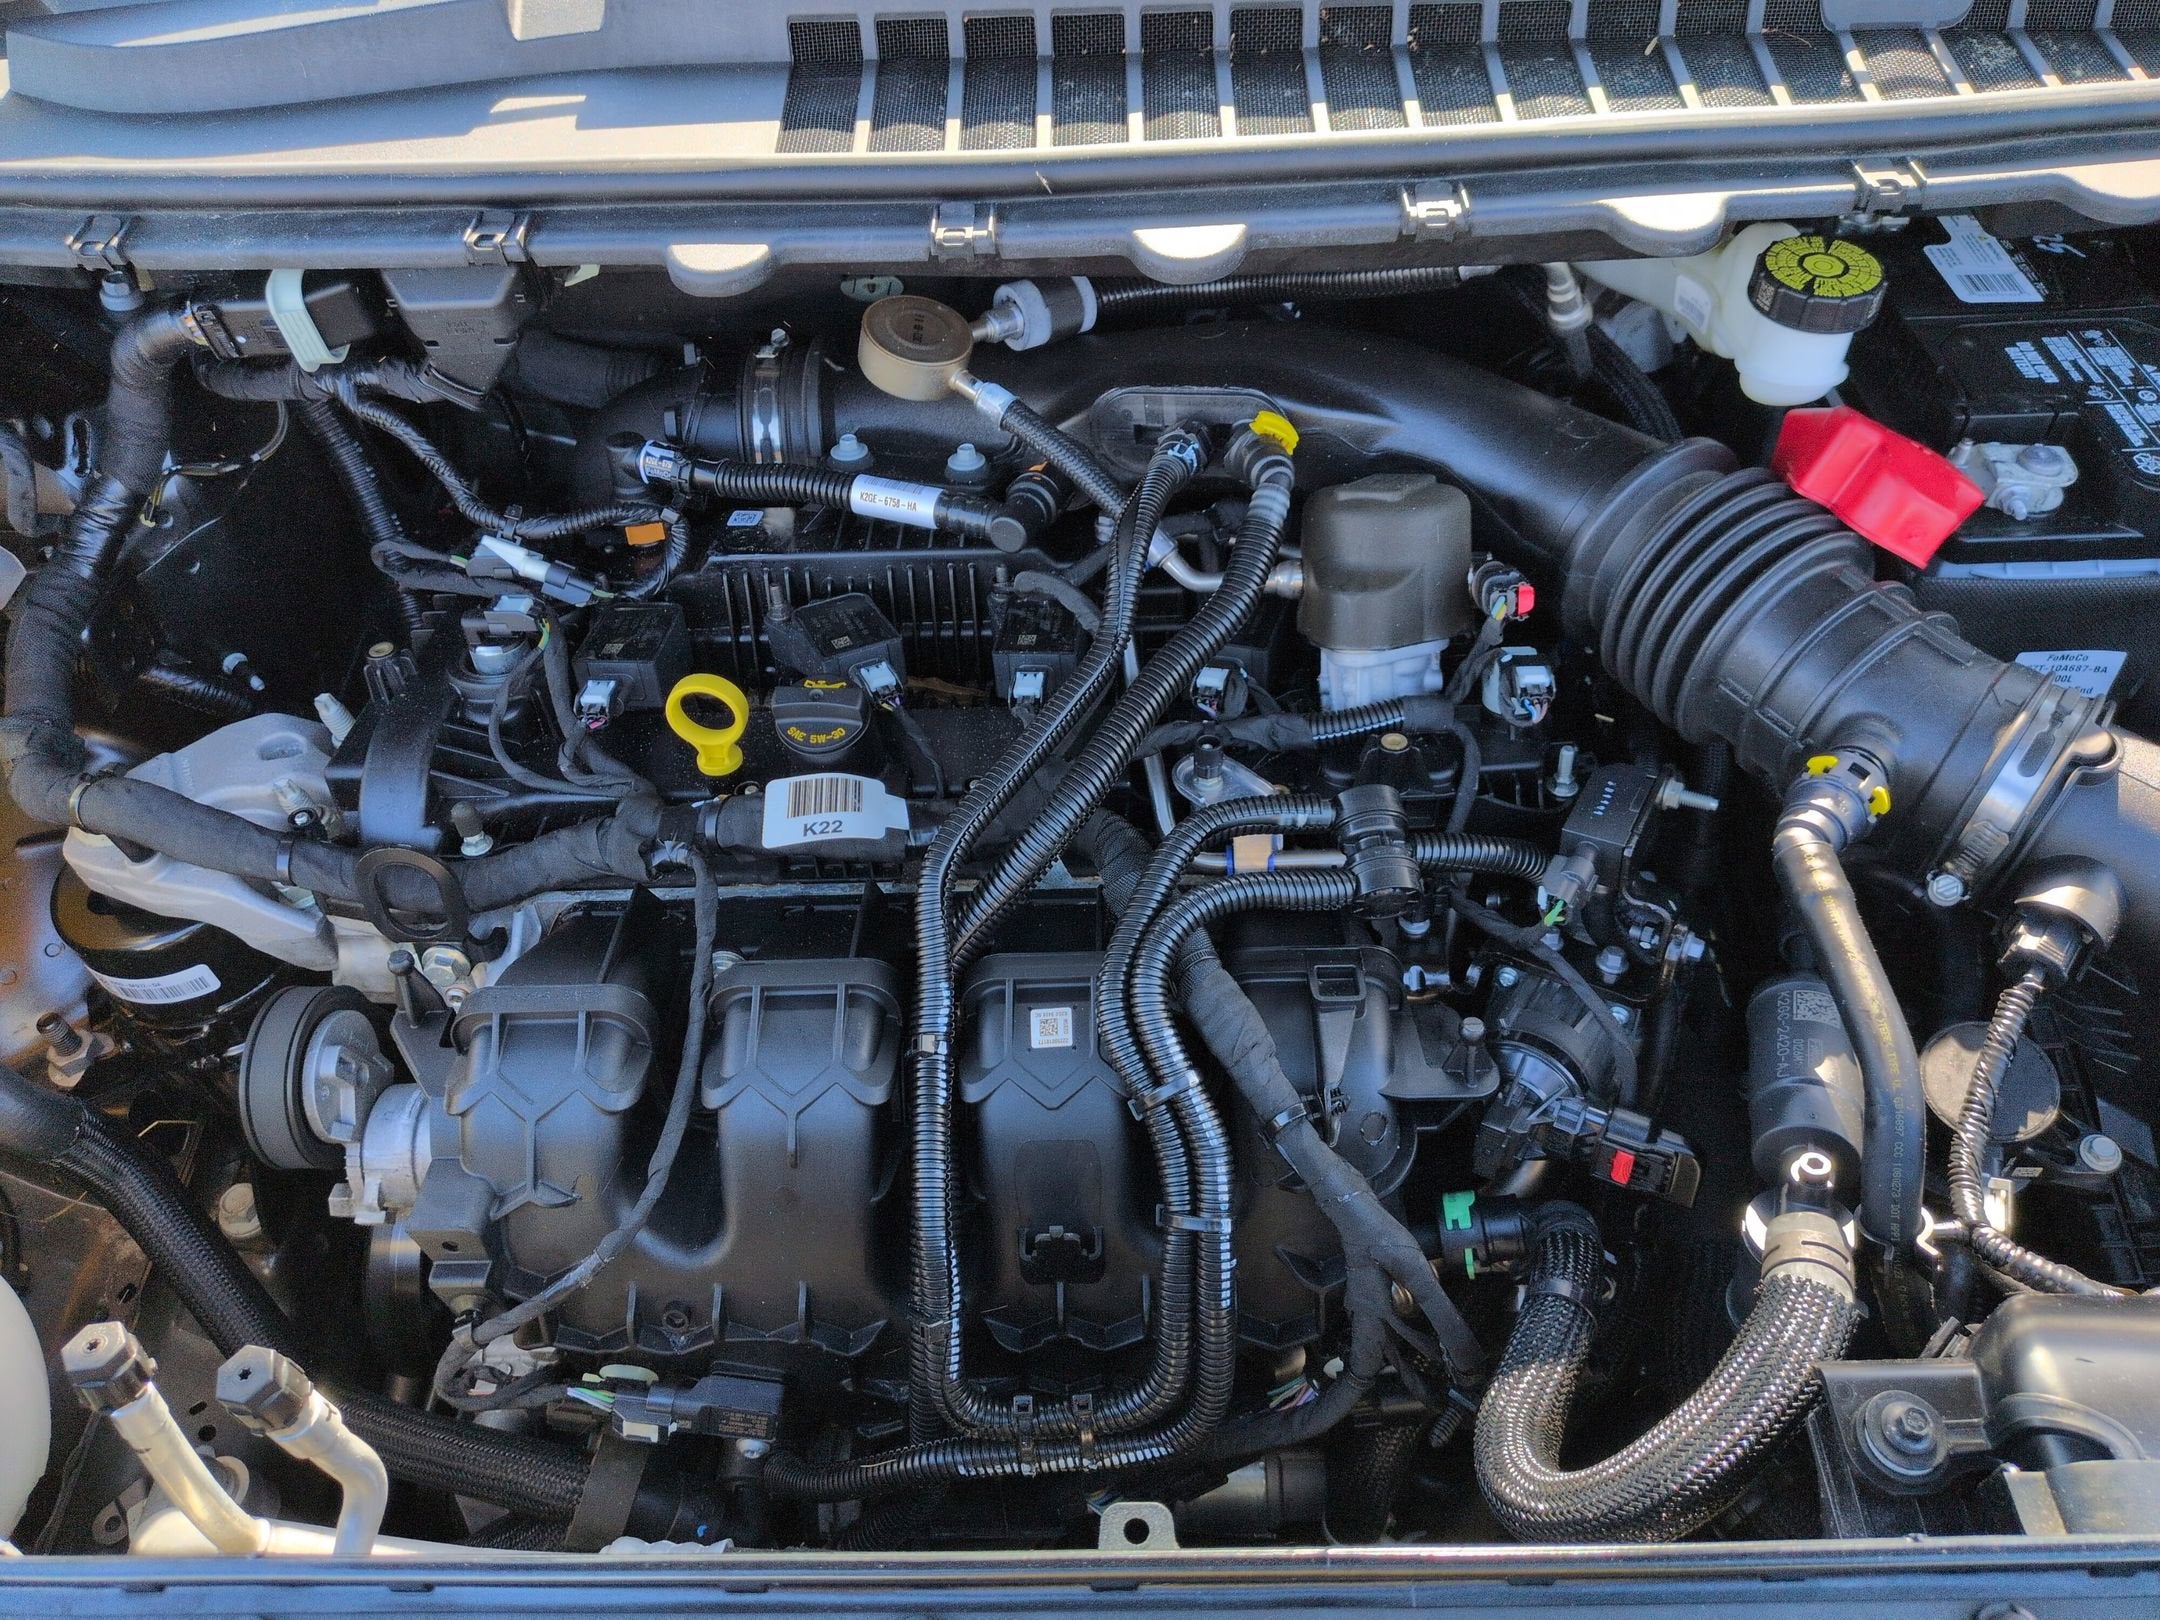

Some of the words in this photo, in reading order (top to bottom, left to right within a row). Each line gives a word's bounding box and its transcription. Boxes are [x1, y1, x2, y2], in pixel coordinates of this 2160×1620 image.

[787, 726, 807, 742] SAE
[809, 727, 846, 744] 5W-30
[803, 820, 843, 837] K22
